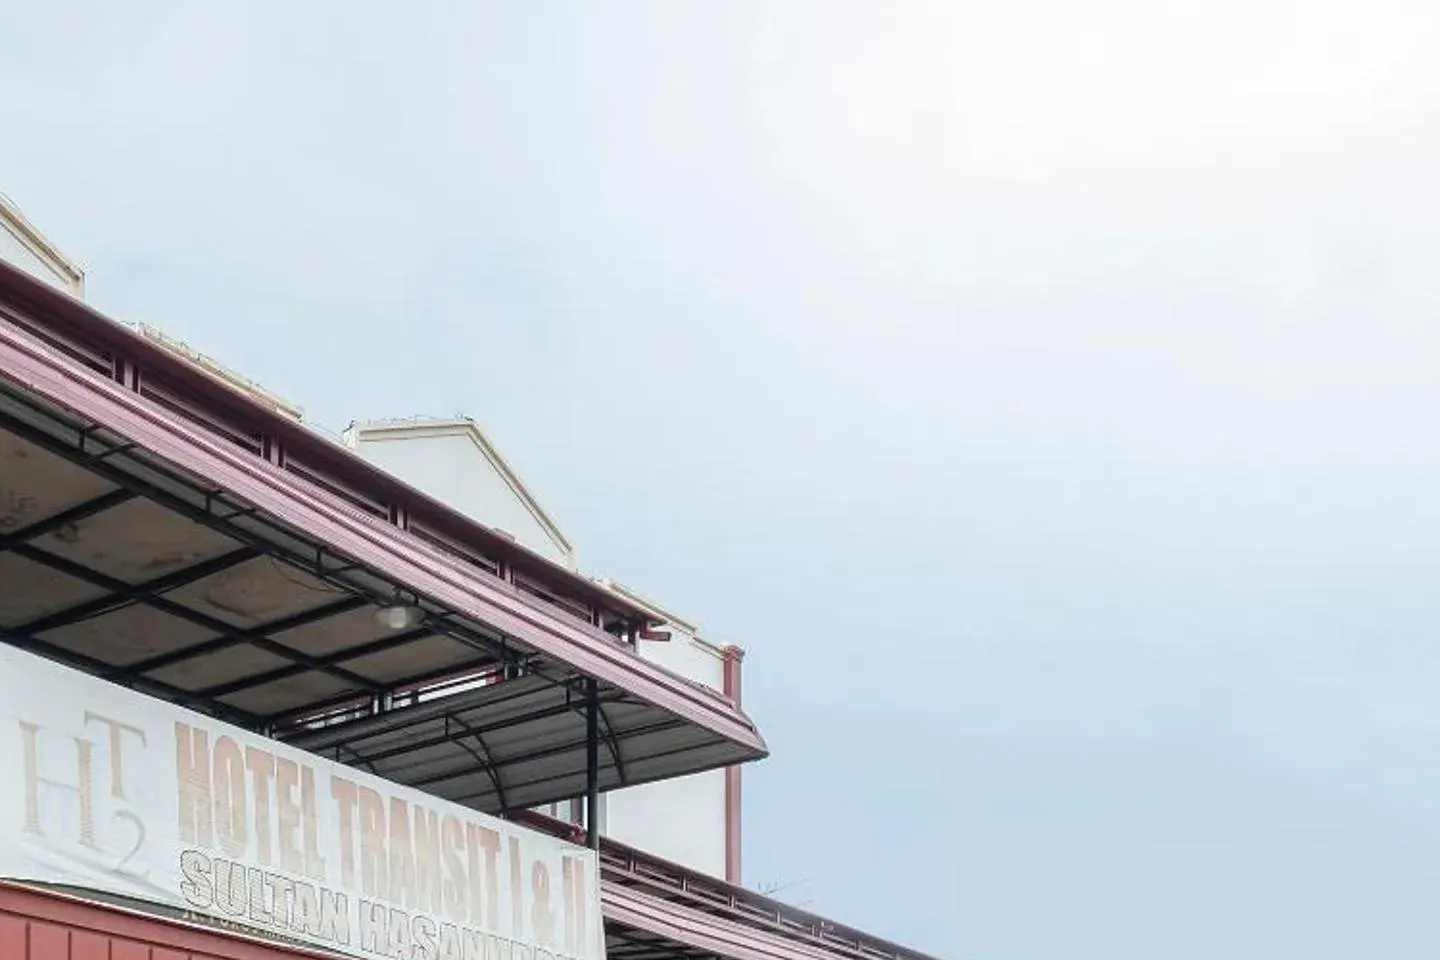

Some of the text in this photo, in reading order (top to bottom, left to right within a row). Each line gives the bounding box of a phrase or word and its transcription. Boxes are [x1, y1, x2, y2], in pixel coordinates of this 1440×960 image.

[174, 720, 327, 882] HOTEL
[331, 774, 502, 931] TRANSIT
[180, 849, 351, 945] SULTAN
